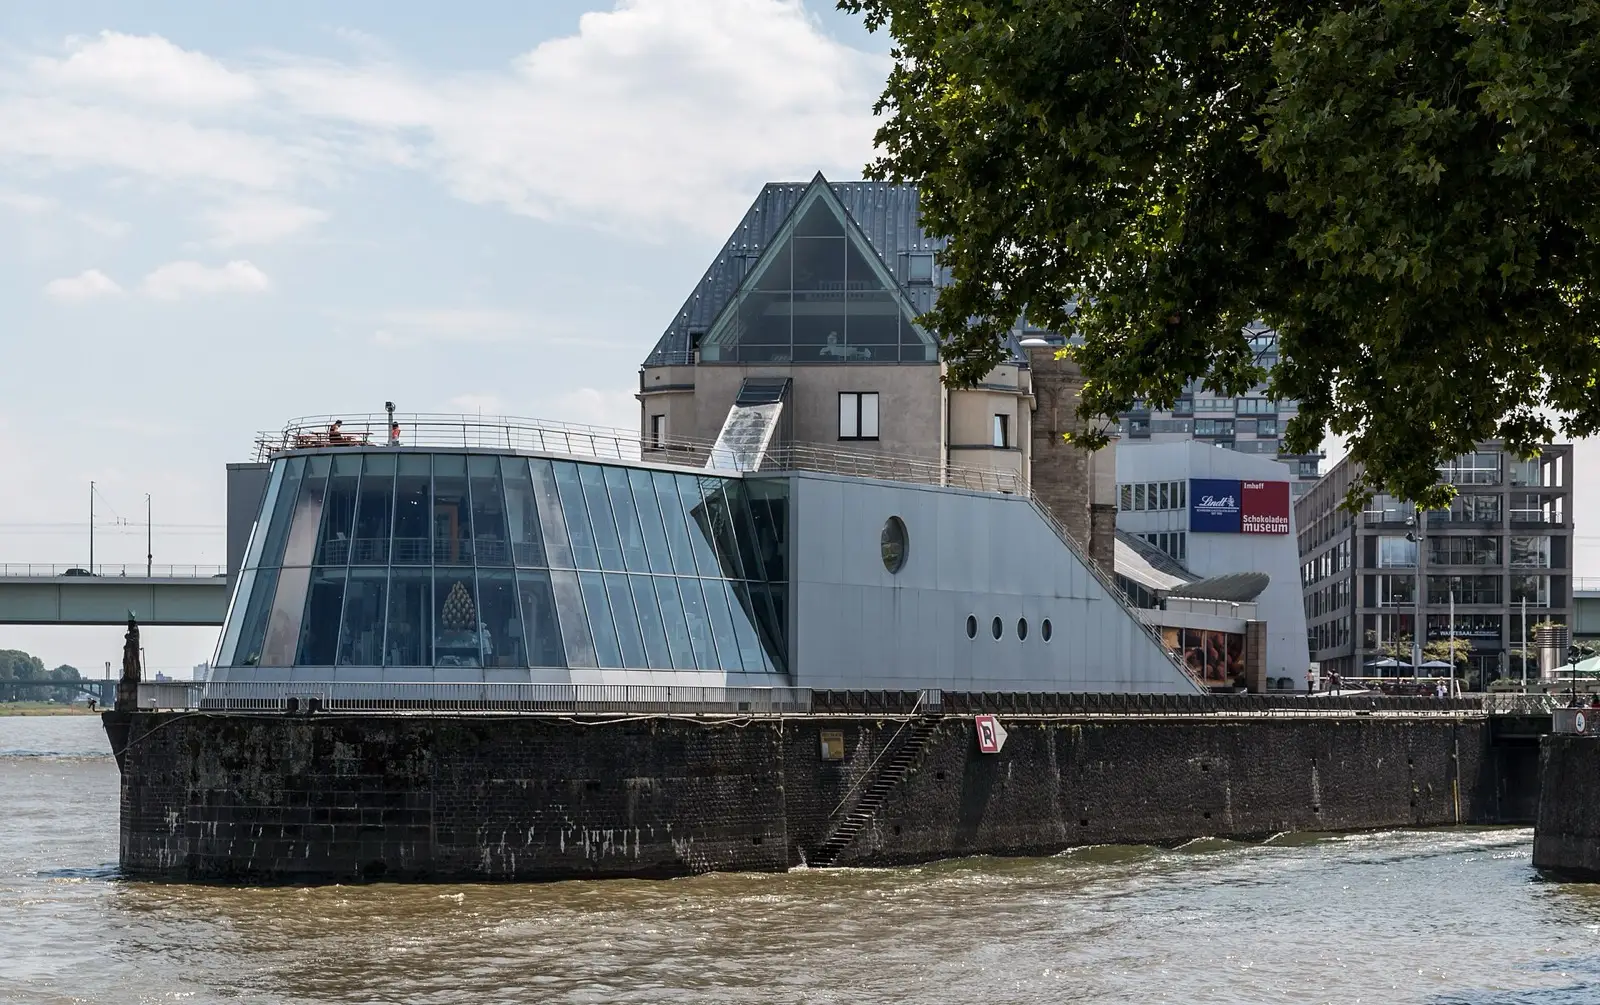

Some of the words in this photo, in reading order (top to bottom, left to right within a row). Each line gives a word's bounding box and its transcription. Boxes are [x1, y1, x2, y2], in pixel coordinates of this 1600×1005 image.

[1244, 482, 1264, 490] Imhoff
[1199, 495, 1228, 507] Lindt
[1243, 515, 1288, 524] Schokoladen
[1243, 523, 1288, 533] museum
